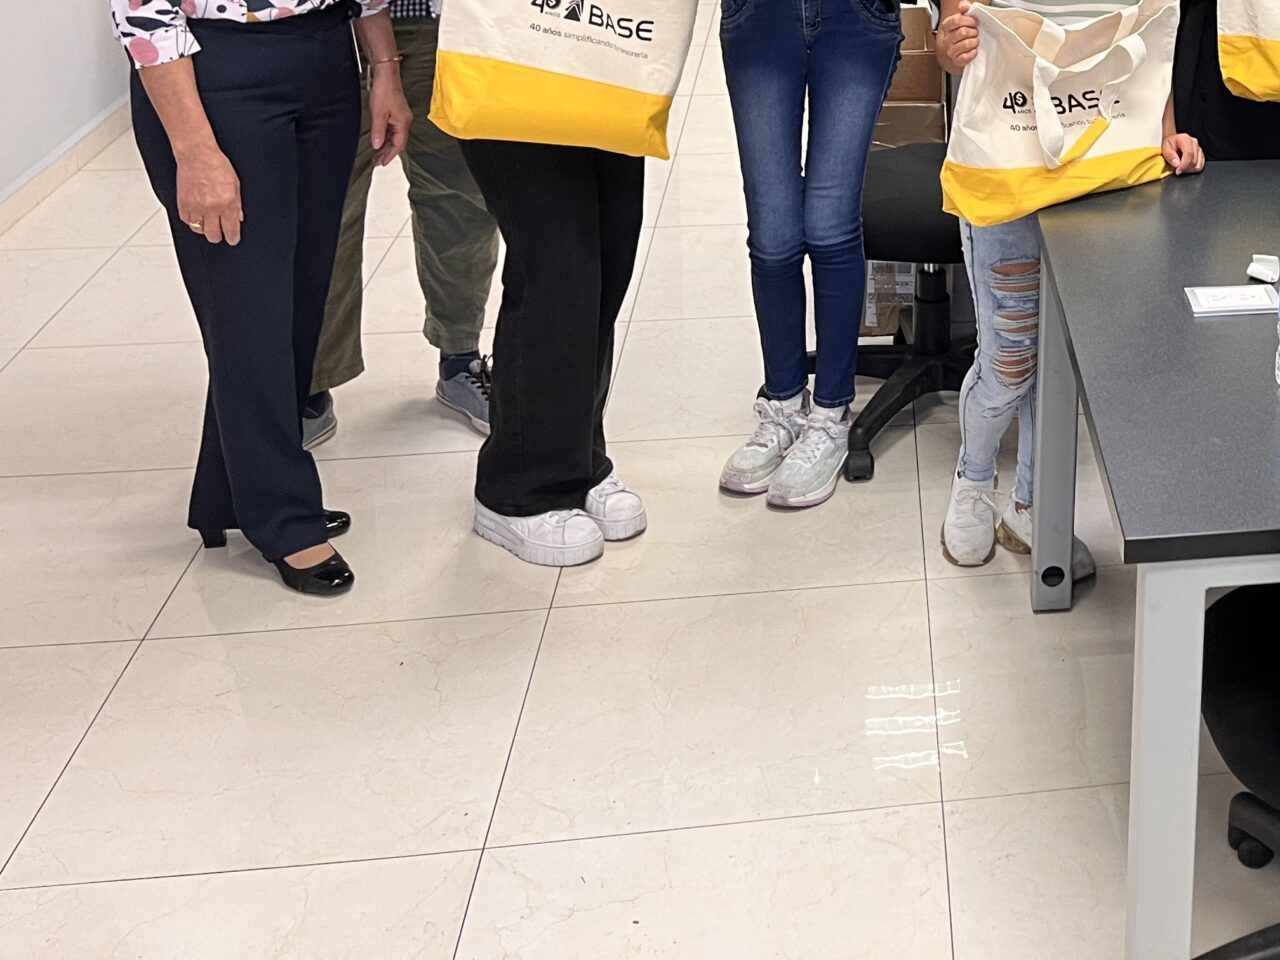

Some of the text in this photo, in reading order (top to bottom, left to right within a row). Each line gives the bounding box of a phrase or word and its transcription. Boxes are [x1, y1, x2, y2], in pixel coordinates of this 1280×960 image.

[529, 23, 541, 32] 40
[588, 4, 655, 42] BASE
[1051, 89, 1120, 115] BAS
